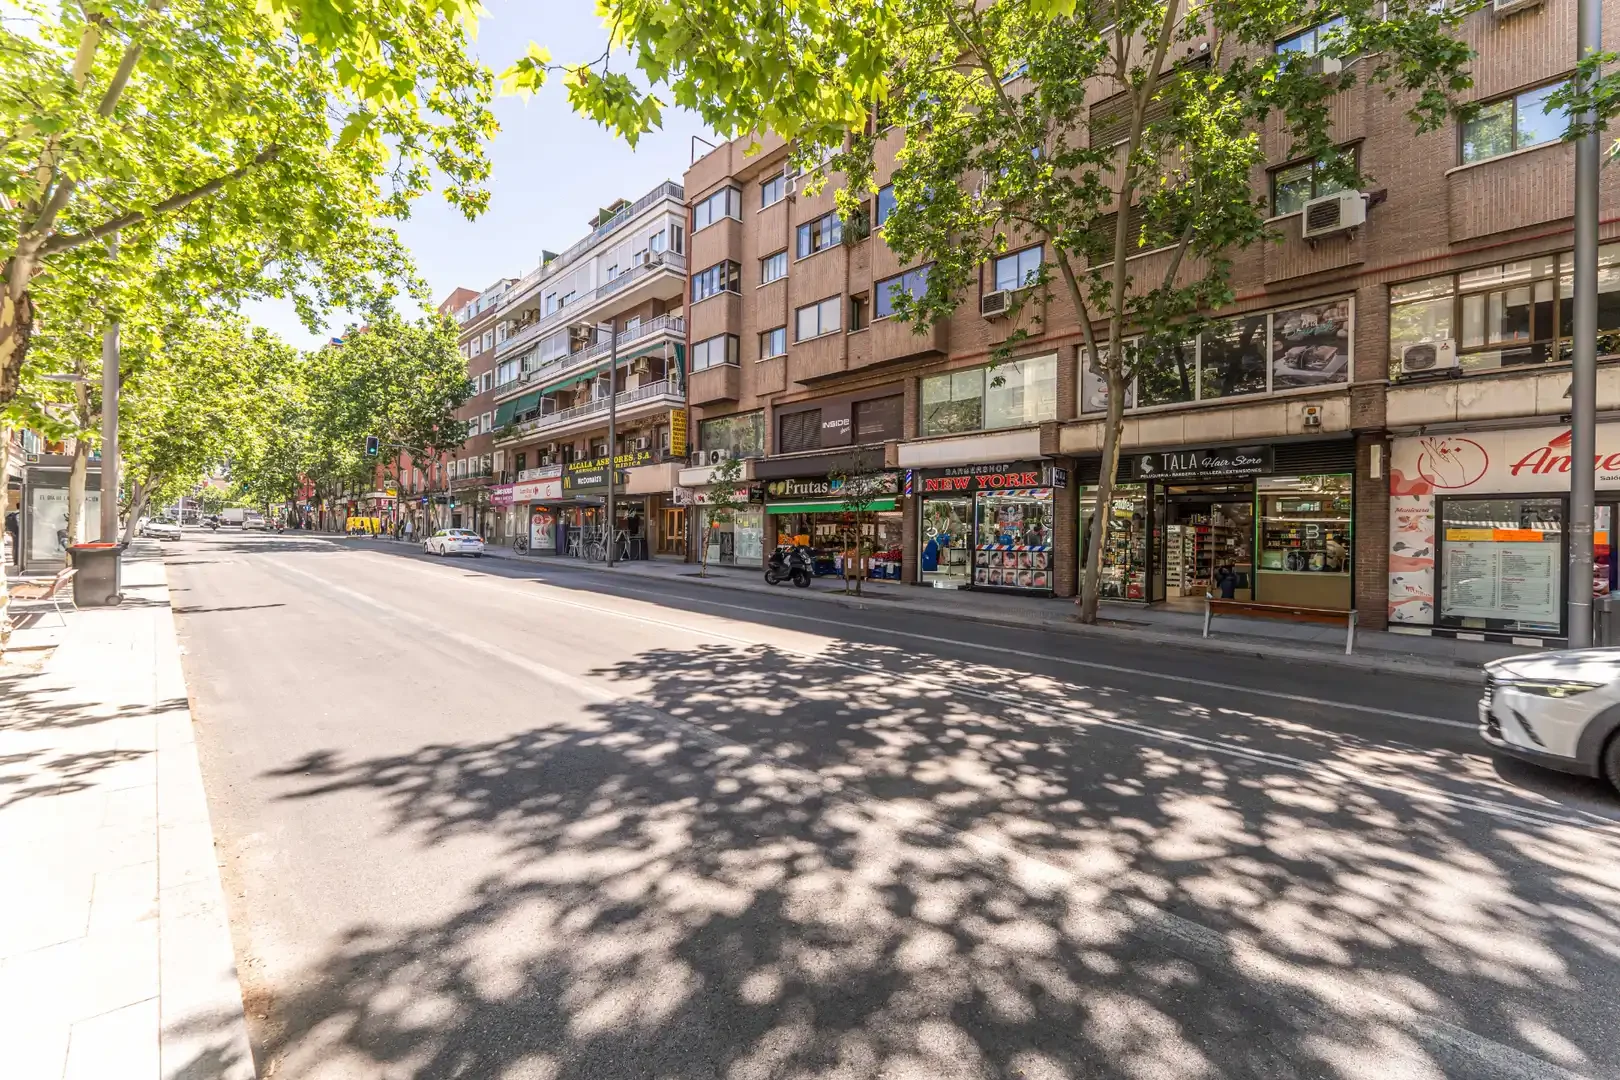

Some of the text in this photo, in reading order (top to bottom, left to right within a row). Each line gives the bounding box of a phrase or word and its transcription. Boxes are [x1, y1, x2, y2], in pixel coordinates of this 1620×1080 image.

[568, 460, 593, 471] ALCALA
[596, 453, 634, 467] ASEORES
[945, 464, 1009, 476] BARBERSHOP
[1161, 453, 1263, 471] TALA Hair Store
[785, 479, 828, 495] Frutas
[925, 475, 971, 491] NEW
[975, 471, 1038, 489] YORK
